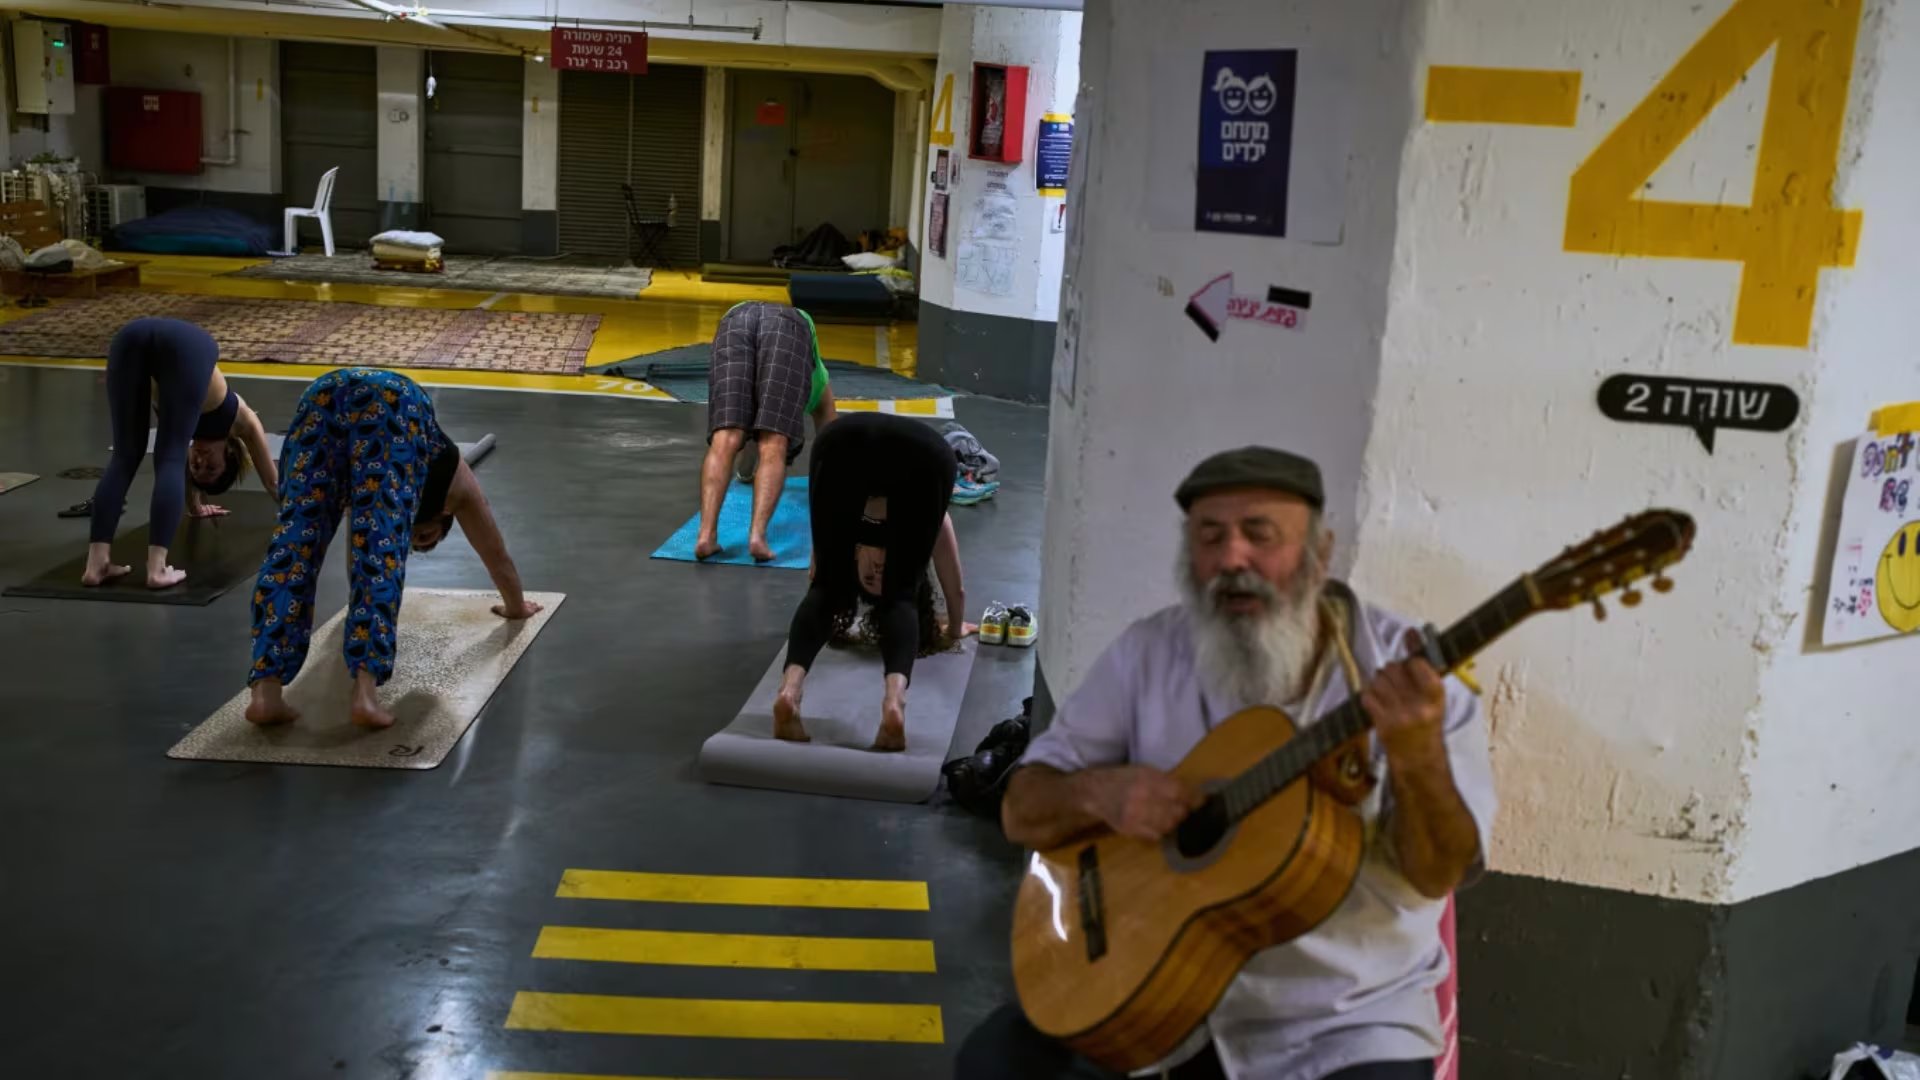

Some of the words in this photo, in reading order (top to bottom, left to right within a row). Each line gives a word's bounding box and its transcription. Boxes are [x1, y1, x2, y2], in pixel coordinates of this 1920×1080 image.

[563, 30, 603, 41] שמורה
[606, 32, 632, 44] חניה
[572, 44, 605, 55] שעות
[607, 45, 622, 57] 24
[591, 59, 603, 69] זר
[607, 59, 628, 70] רכב
[1221, 121, 1269, 140] מתחם
[1223, 140, 1266, 161] ילדים
[1624, 383, 1651, 412] 2
